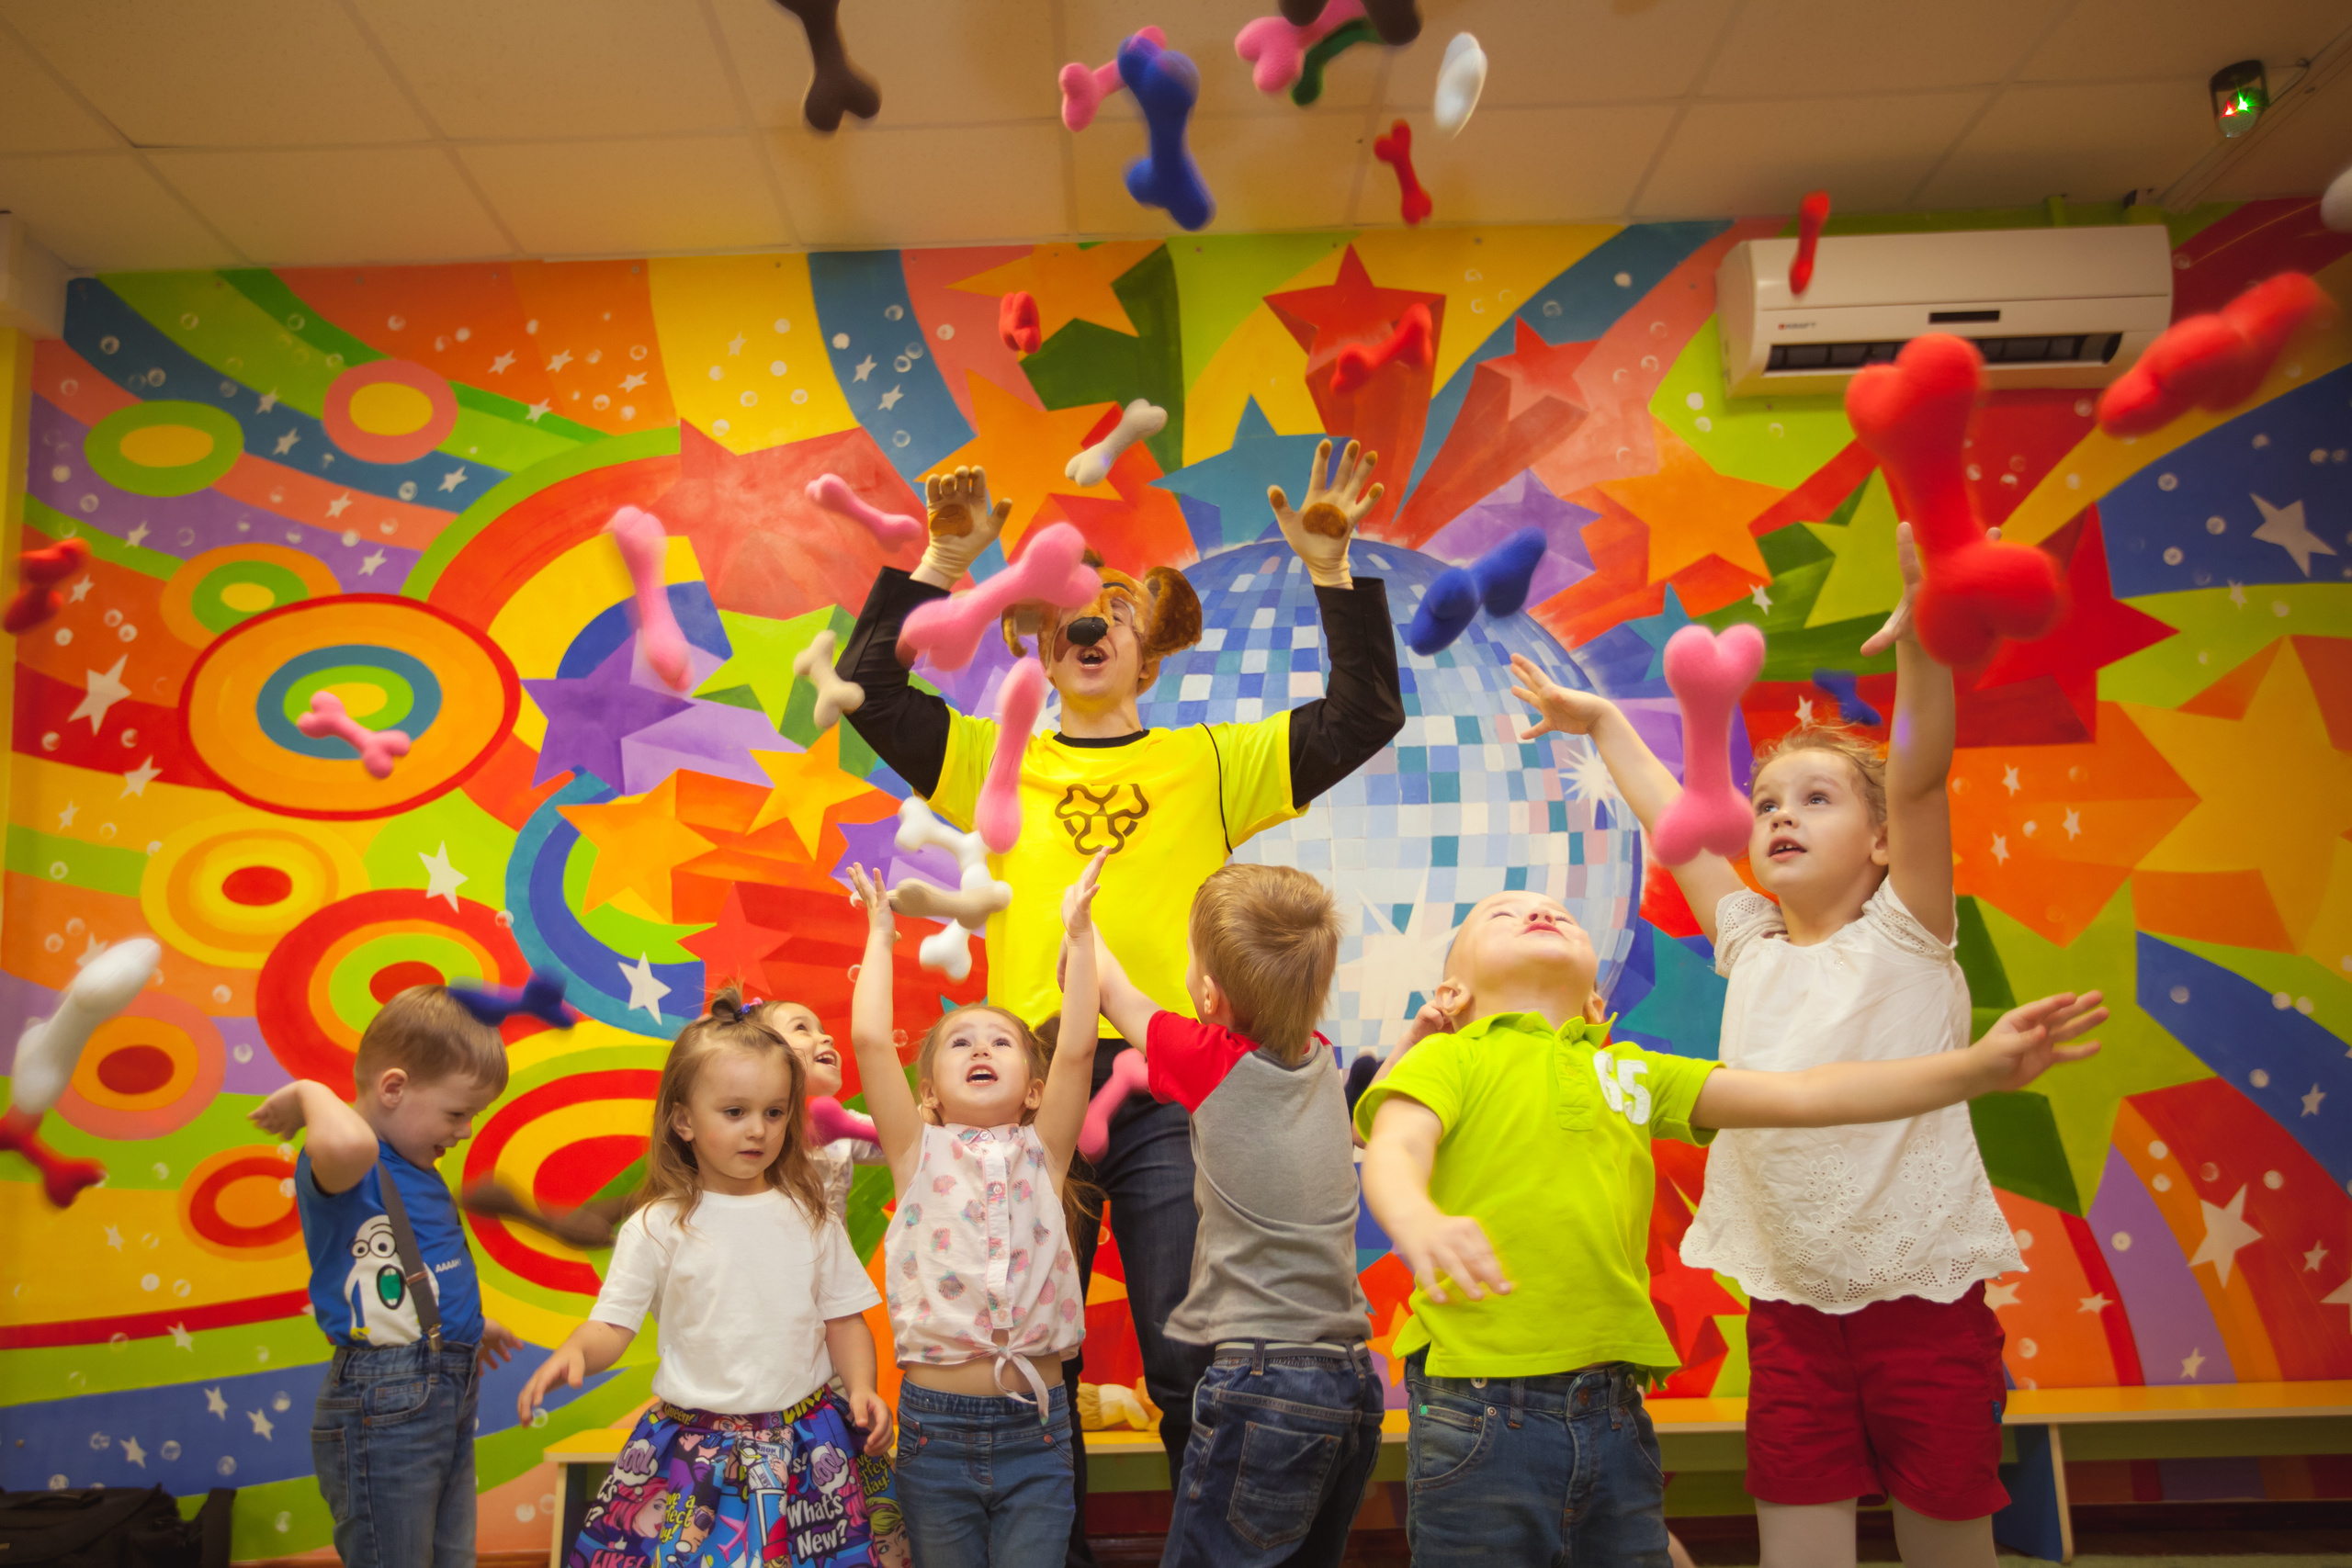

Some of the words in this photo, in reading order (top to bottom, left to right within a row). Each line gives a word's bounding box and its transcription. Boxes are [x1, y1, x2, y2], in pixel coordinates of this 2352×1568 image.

[1592, 1050, 1652, 1126] 65
[787, 1493, 844, 1529] What's
[797, 1518, 848, 1559] New?
